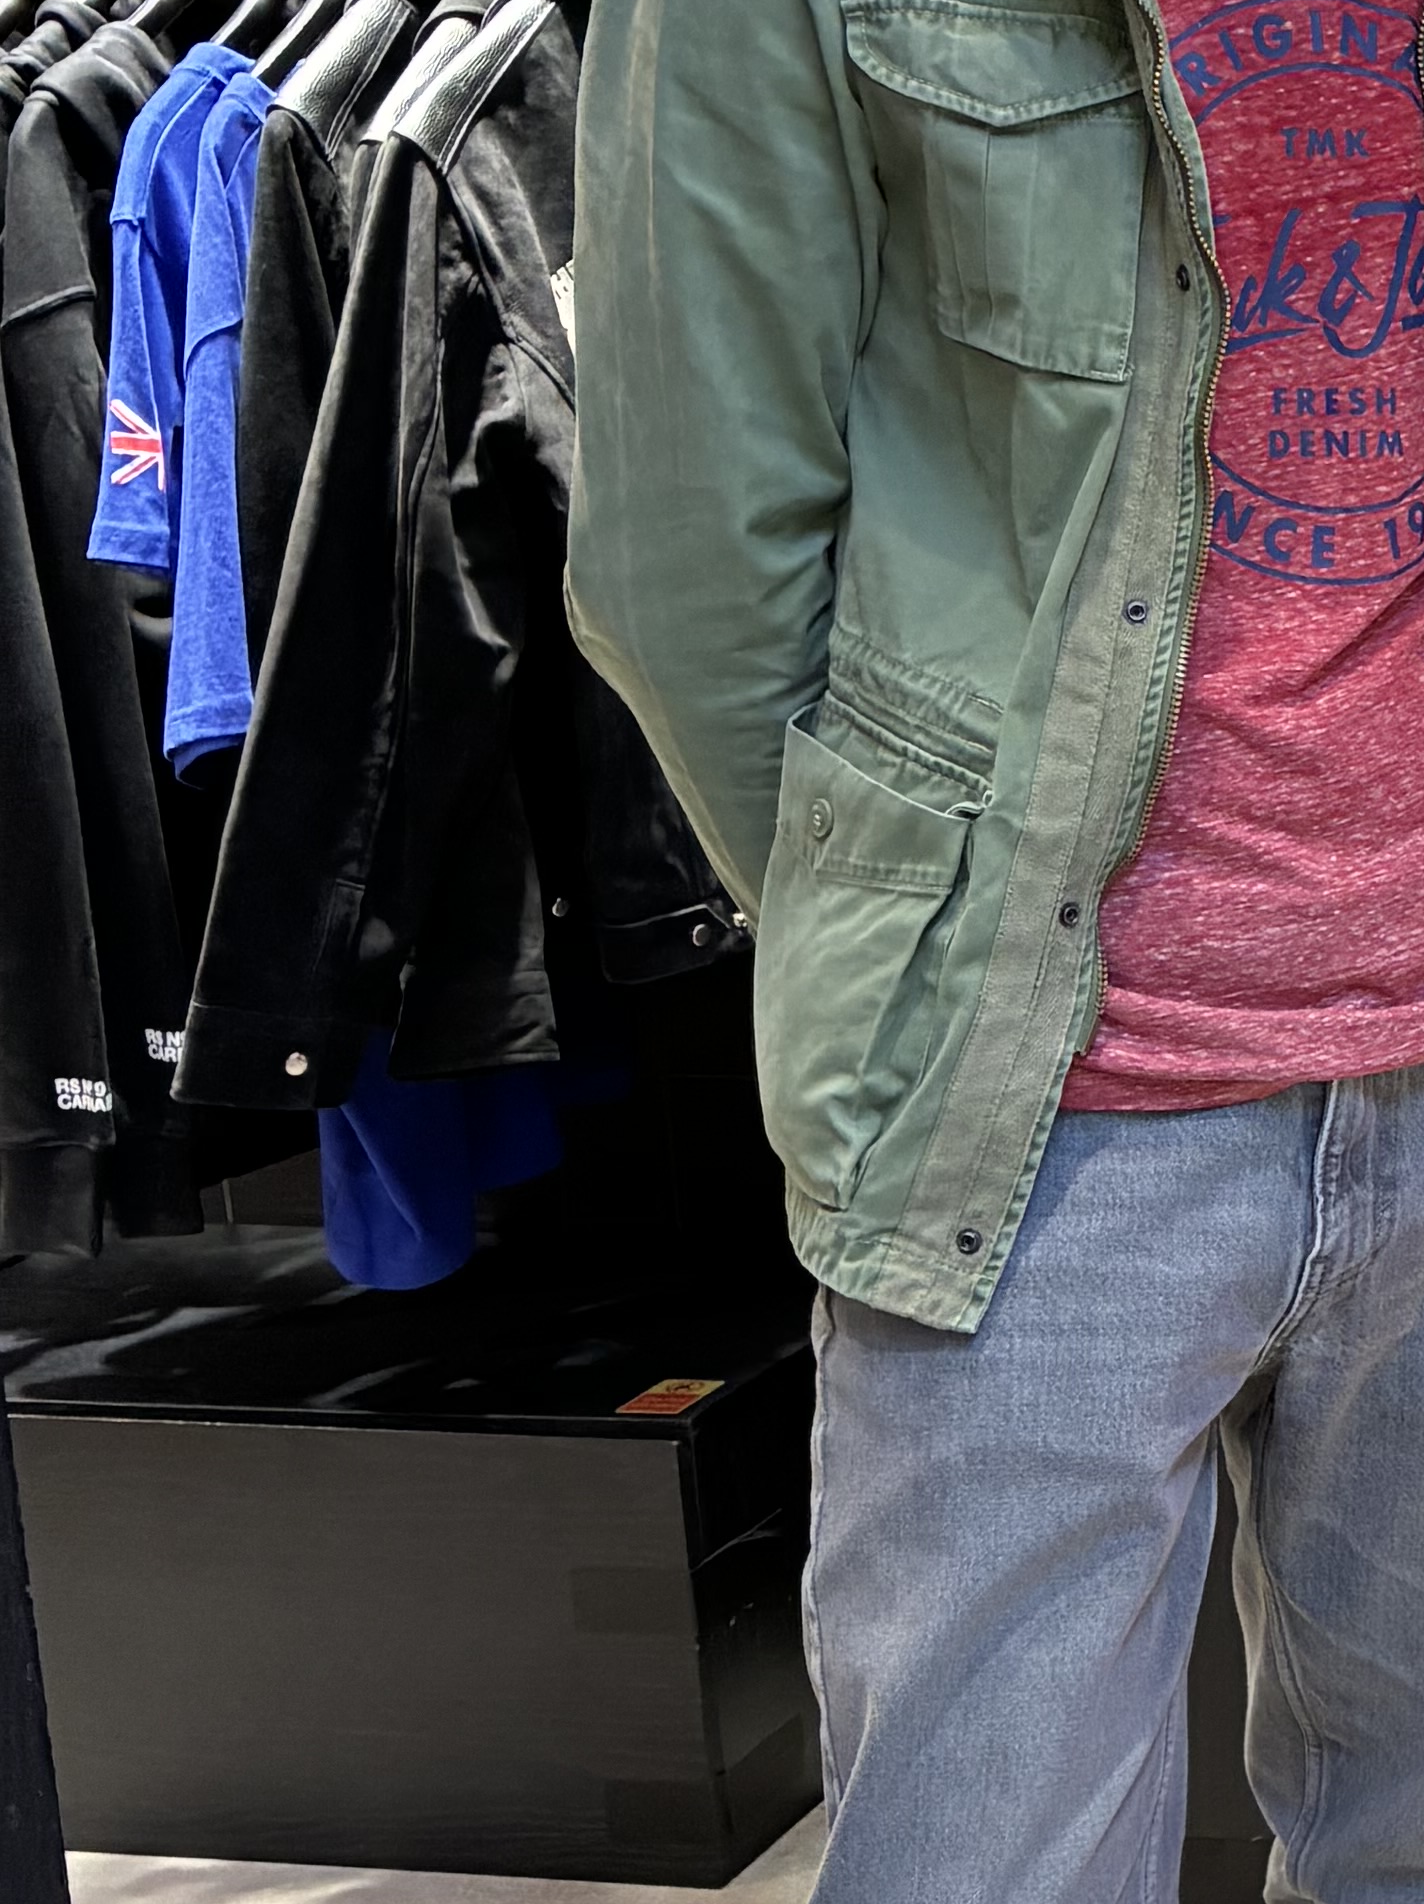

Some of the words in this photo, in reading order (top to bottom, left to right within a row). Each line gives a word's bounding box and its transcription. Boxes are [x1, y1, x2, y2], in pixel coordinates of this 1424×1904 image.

[1174, 9, 1421, 96] RIGINA
[1280, 127, 1370, 159] TMK
[1271, 386, 1397, 416] FRESH
[1267, 430, 1404, 459] DENIM
[1212, 489, 1336, 569] NCE
[148, 1044, 184, 1062] CAR
